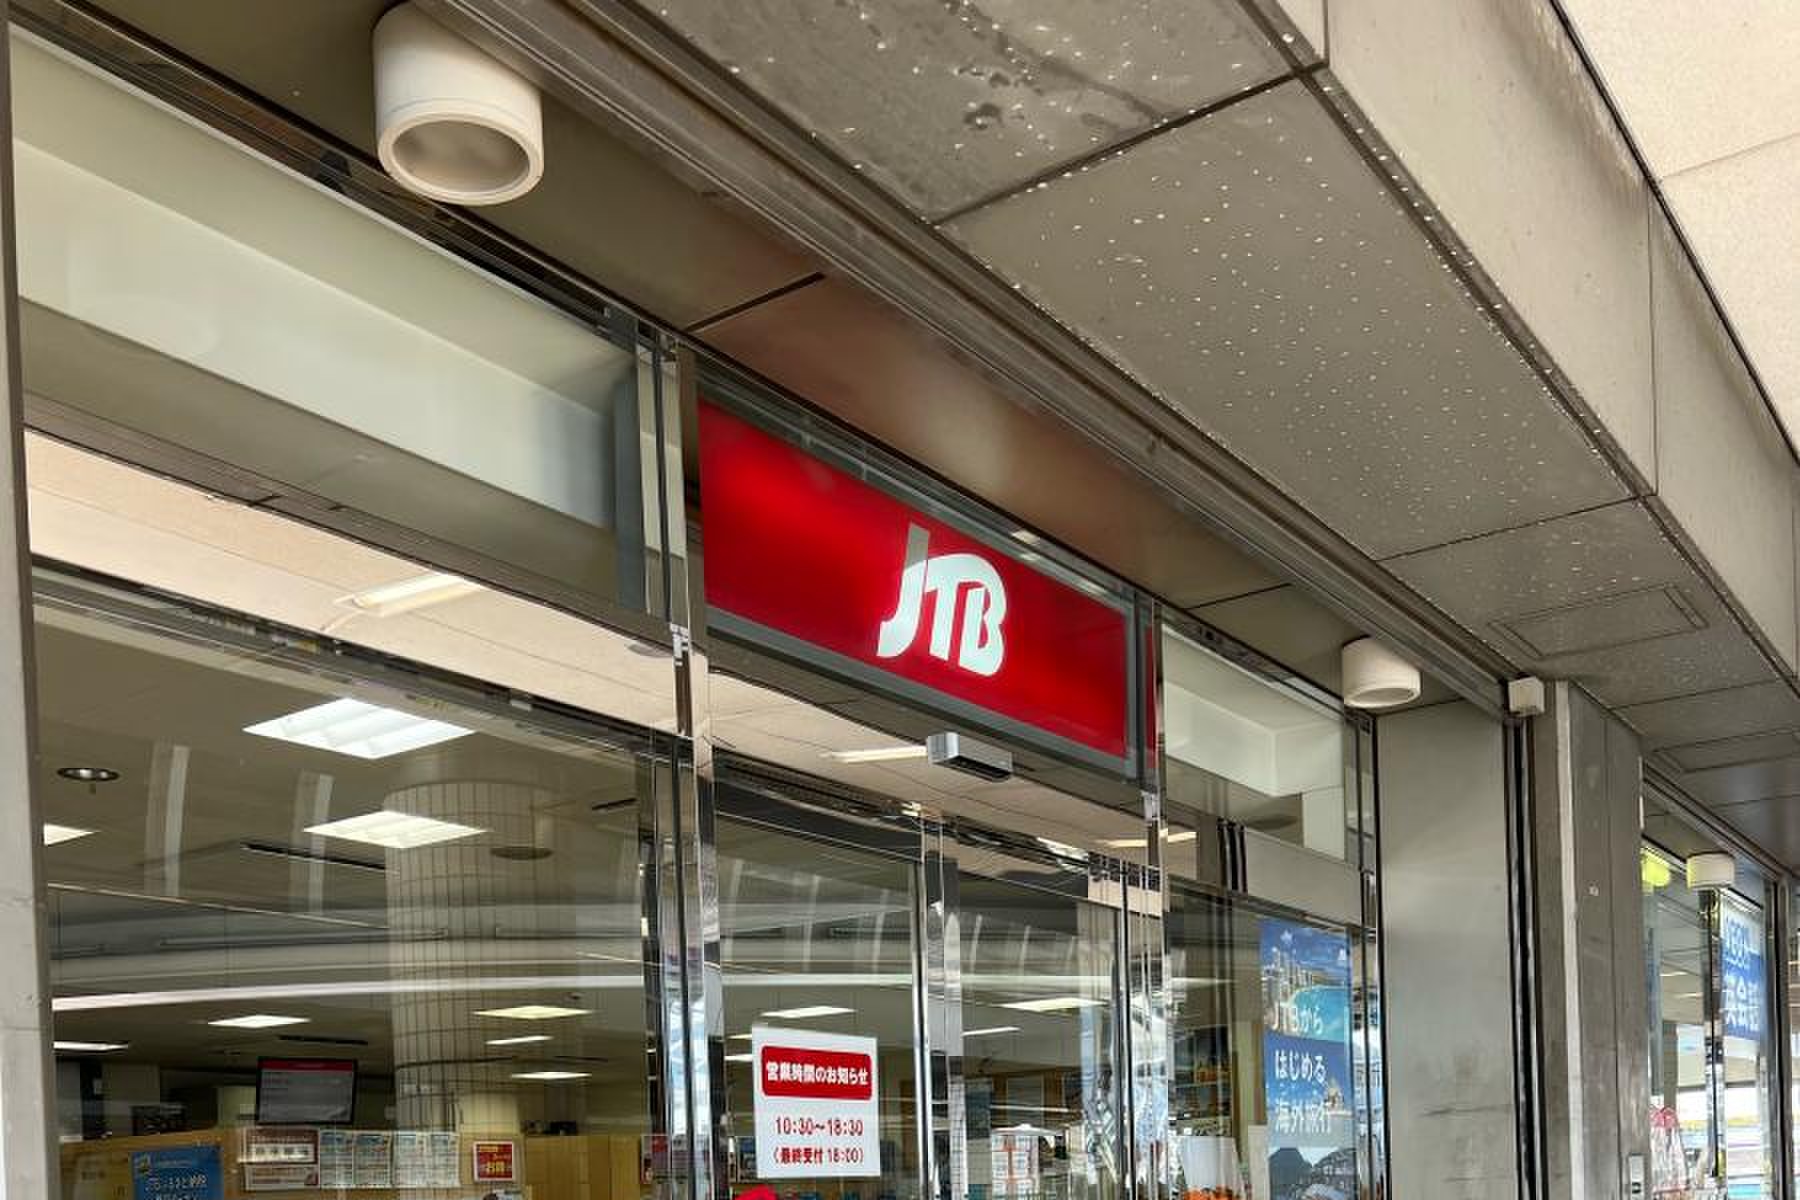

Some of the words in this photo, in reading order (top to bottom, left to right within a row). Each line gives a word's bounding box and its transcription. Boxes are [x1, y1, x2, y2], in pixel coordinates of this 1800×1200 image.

[876, 521, 1007, 677] JTB
[766, 1061, 869, 1086] 営業時間のお知らせ
[1274, 1049, 1328, 1085] はじめる
